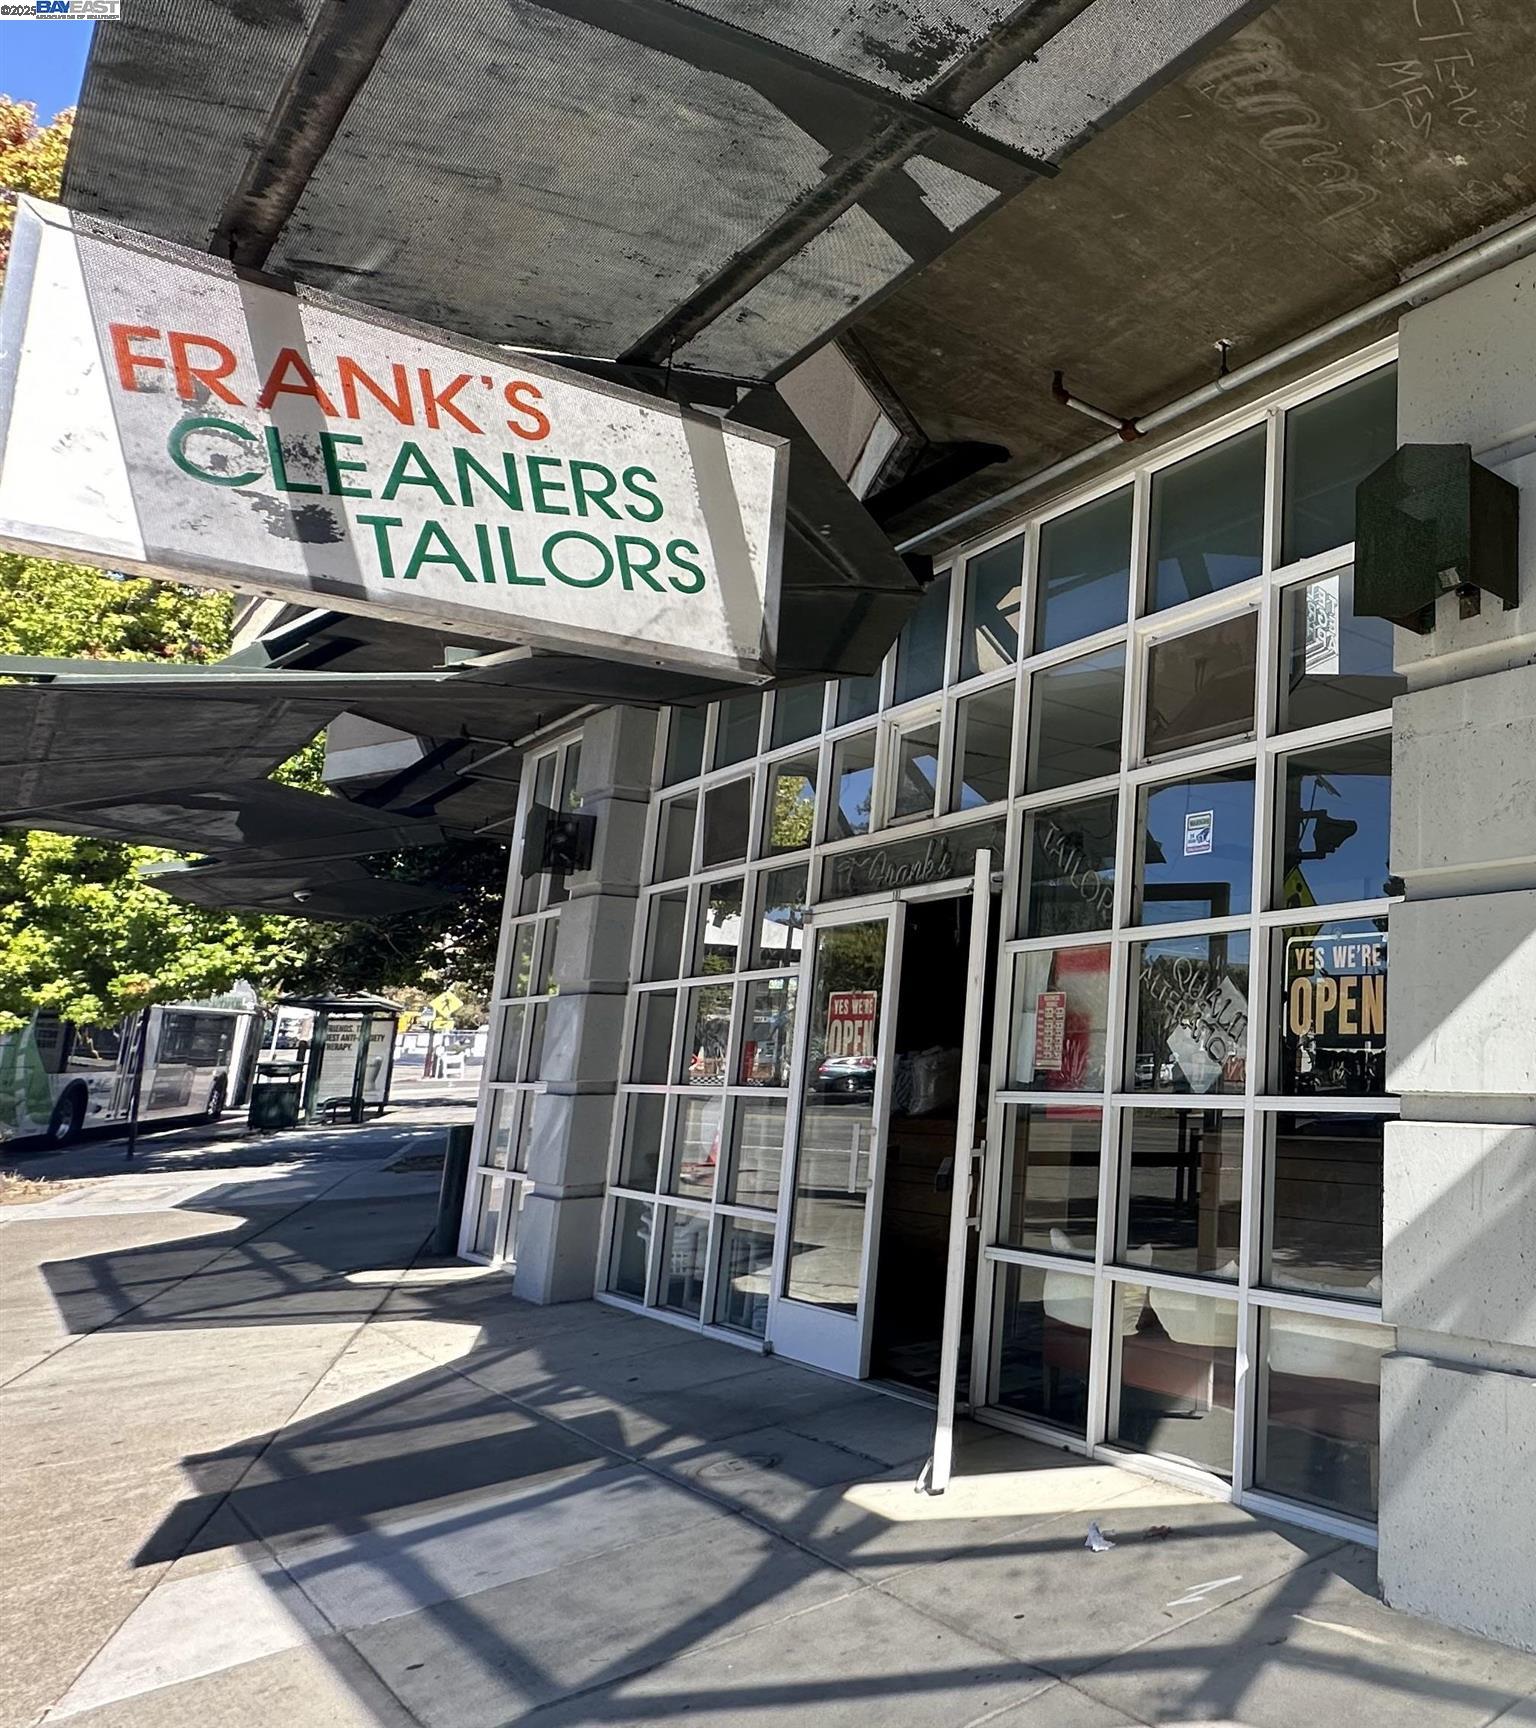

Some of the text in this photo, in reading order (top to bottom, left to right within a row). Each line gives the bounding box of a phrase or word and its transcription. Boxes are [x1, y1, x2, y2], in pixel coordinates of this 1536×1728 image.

[109, 323, 550, 441] FRANK'S
[166, 417, 664, 522] CLEANERS
[355, 514, 706, 594] TAILORS
[1295, 943, 1381, 970] YES WE'RE
[834, 999, 849, 1015] YES
[1290, 975, 1384, 1036] OPEN
[828, 1019, 873, 1057] OPEN
